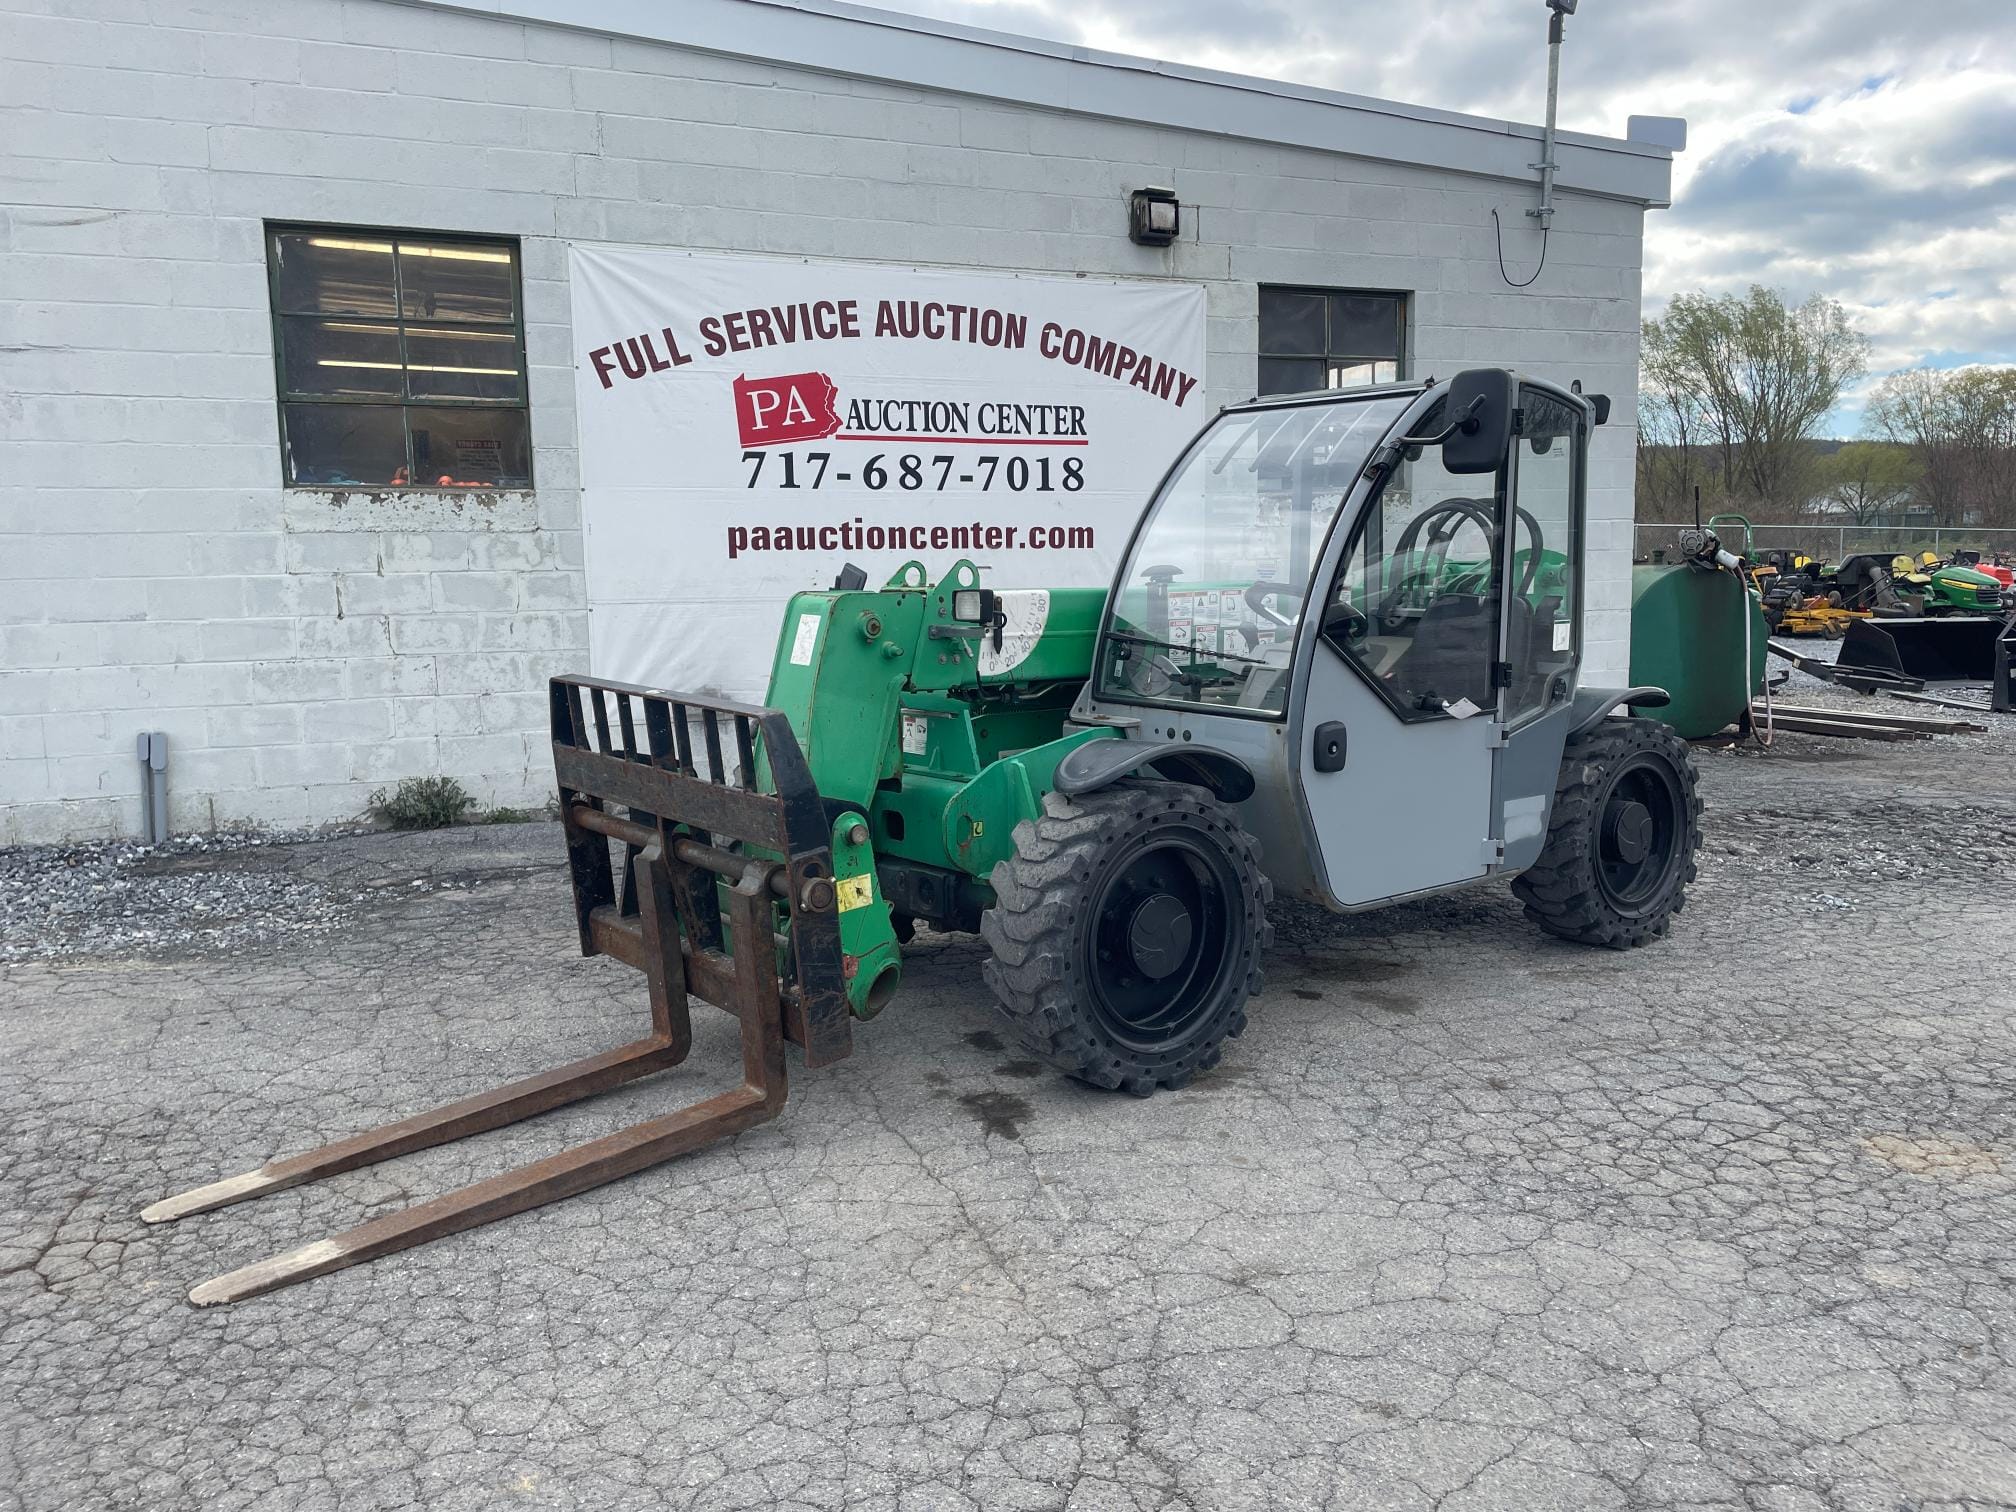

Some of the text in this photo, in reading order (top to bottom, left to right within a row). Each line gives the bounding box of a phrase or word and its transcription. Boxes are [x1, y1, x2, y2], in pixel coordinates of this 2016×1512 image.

[589, 300, 1197, 408] FULL SERVICE AUCTION COMPANY
[746, 385, 1087, 436] PA AUCTION CENTER
[741, 451, 1085, 492] 717-687-7018
[728, 517, 1094, 558] paauctioncenter.com
